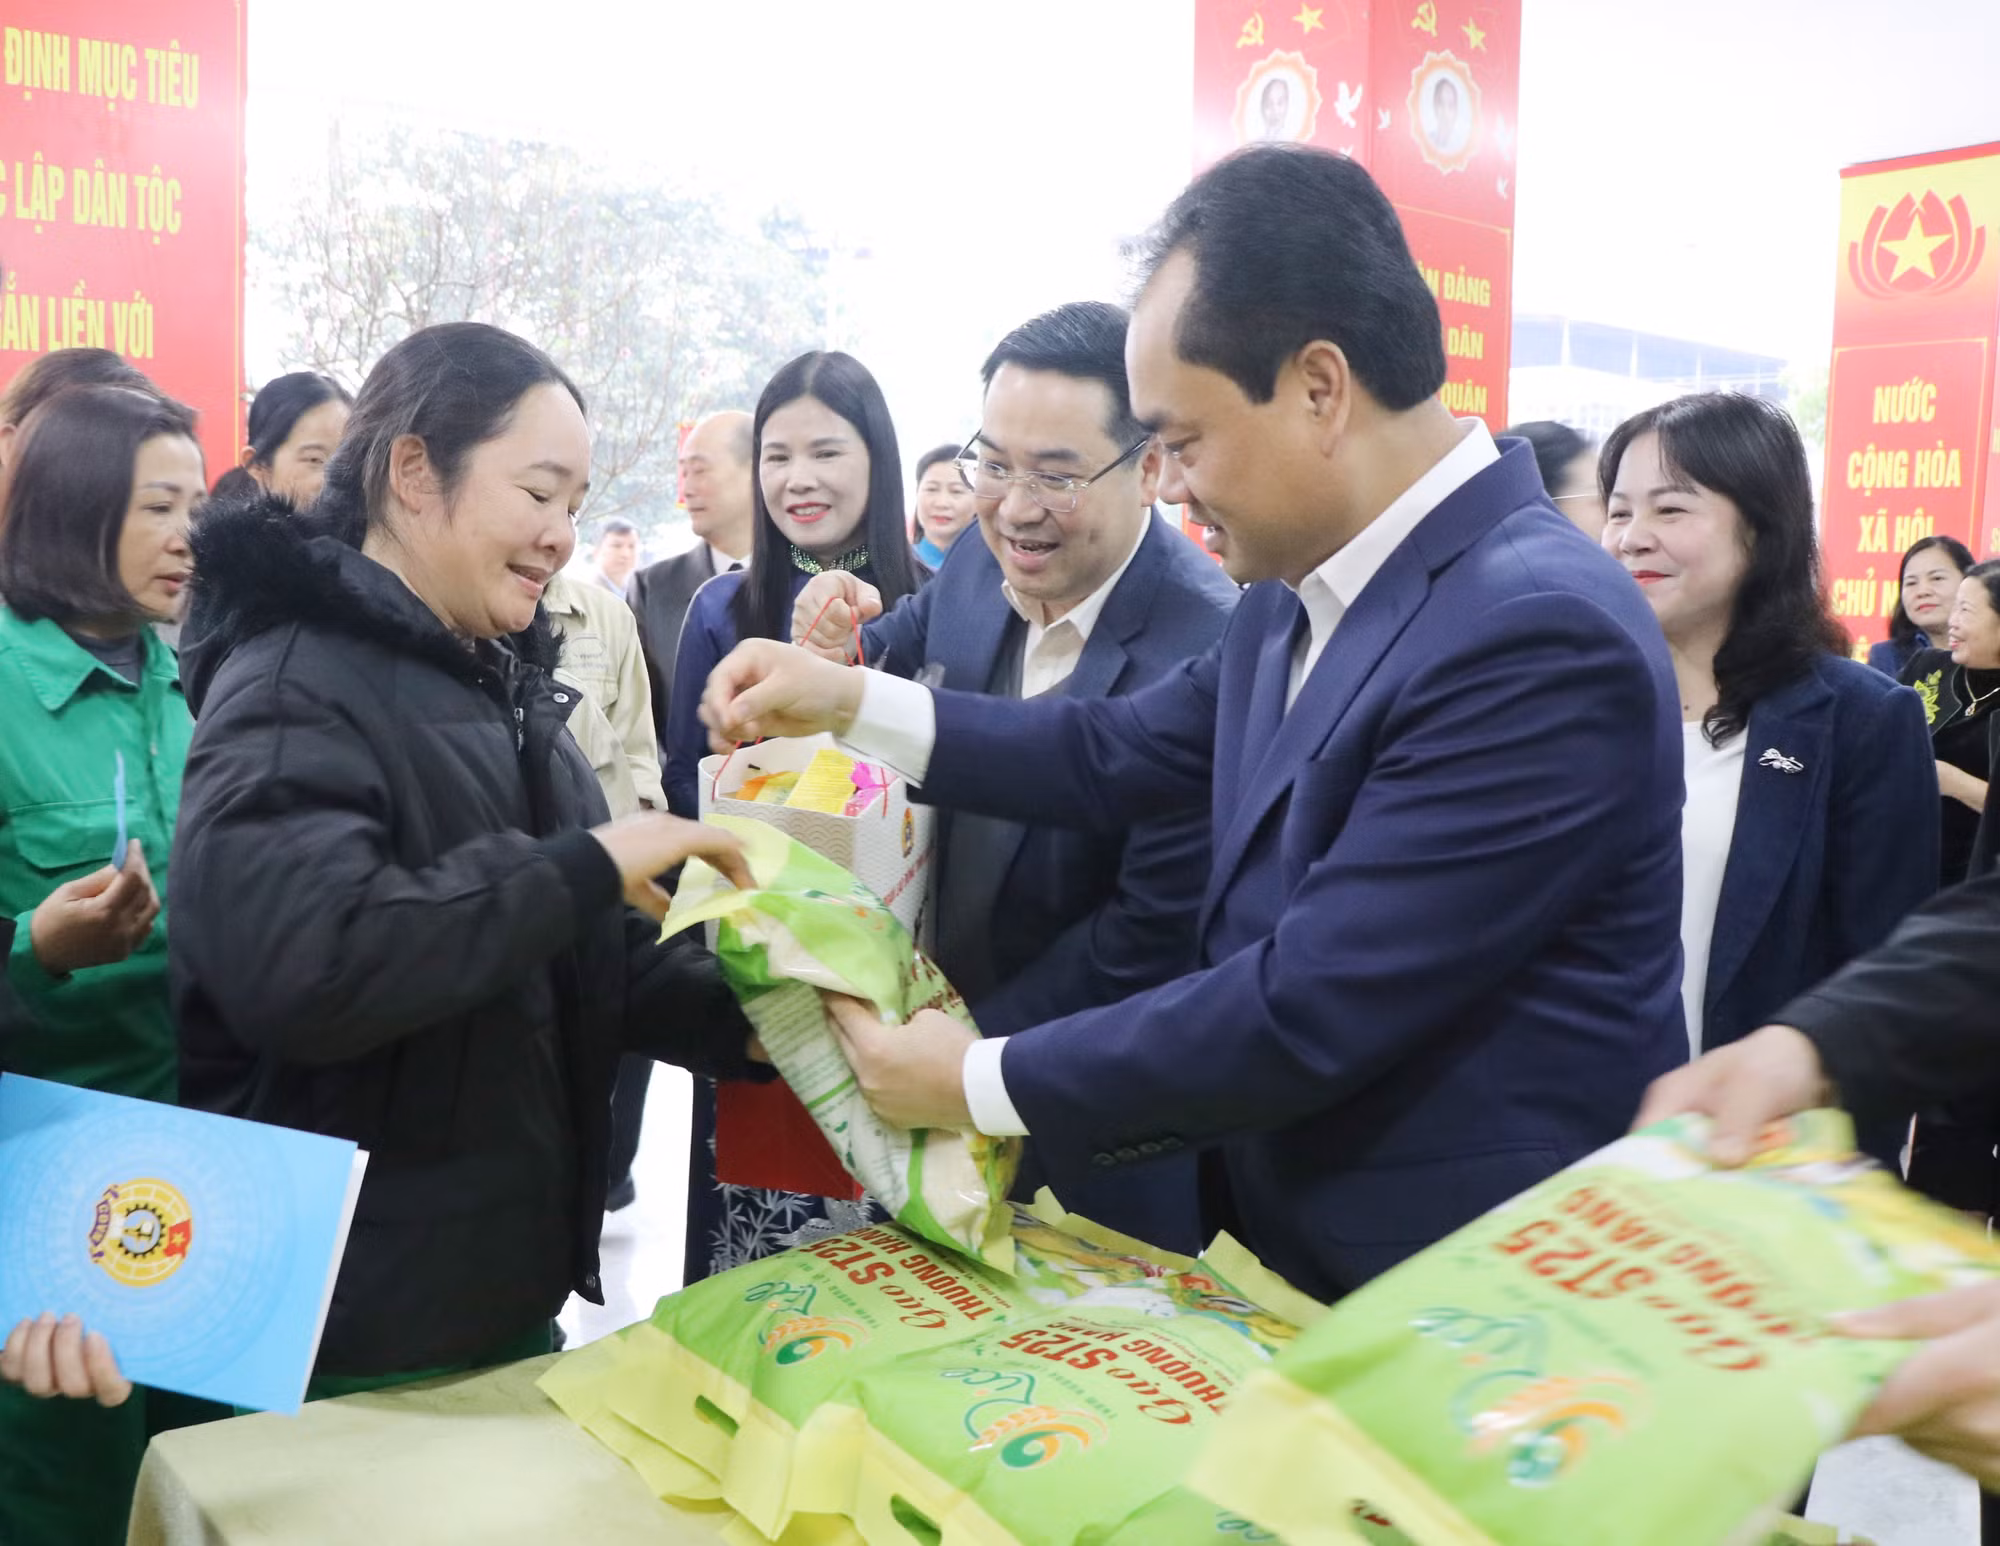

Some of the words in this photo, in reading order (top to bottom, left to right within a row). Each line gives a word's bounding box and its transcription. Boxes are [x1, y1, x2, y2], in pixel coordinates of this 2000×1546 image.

[5, 26, 70, 101] ĐỊNH
[78, 37, 137, 112] MỤC
[145, 39, 200, 109] TIÊU
[15, 151, 65, 234] LẬP
[73, 158, 127, 228] DÂN
[134, 164, 182, 245] TỘC
[1443, 265, 1491, 307] ĐẢNG
[0, 271, 40, 352] ẮN
[48, 279, 105, 352] LIỀN
[112, 290, 154, 359] VỚI
[1447, 323, 1484, 359] DÂN
[1440, 379, 1488, 414] QUÂN
[1872, 375, 1937, 424] NƯỚC
[1847, 442, 1909, 497] CỘNG
[1913, 440, 1962, 488] HÒA
[1857, 508, 1889, 553] XÃ
[1832, 566, 1877, 618] CHỦ
[800, 1238, 895, 1285] ST25
[879, 1284, 948, 1330] Gạo
[899, 1254, 994, 1320] THƯỢNG
[999, 1329, 1119, 1369] ST25
[1105, 1367, 1194, 1425] Gạo
